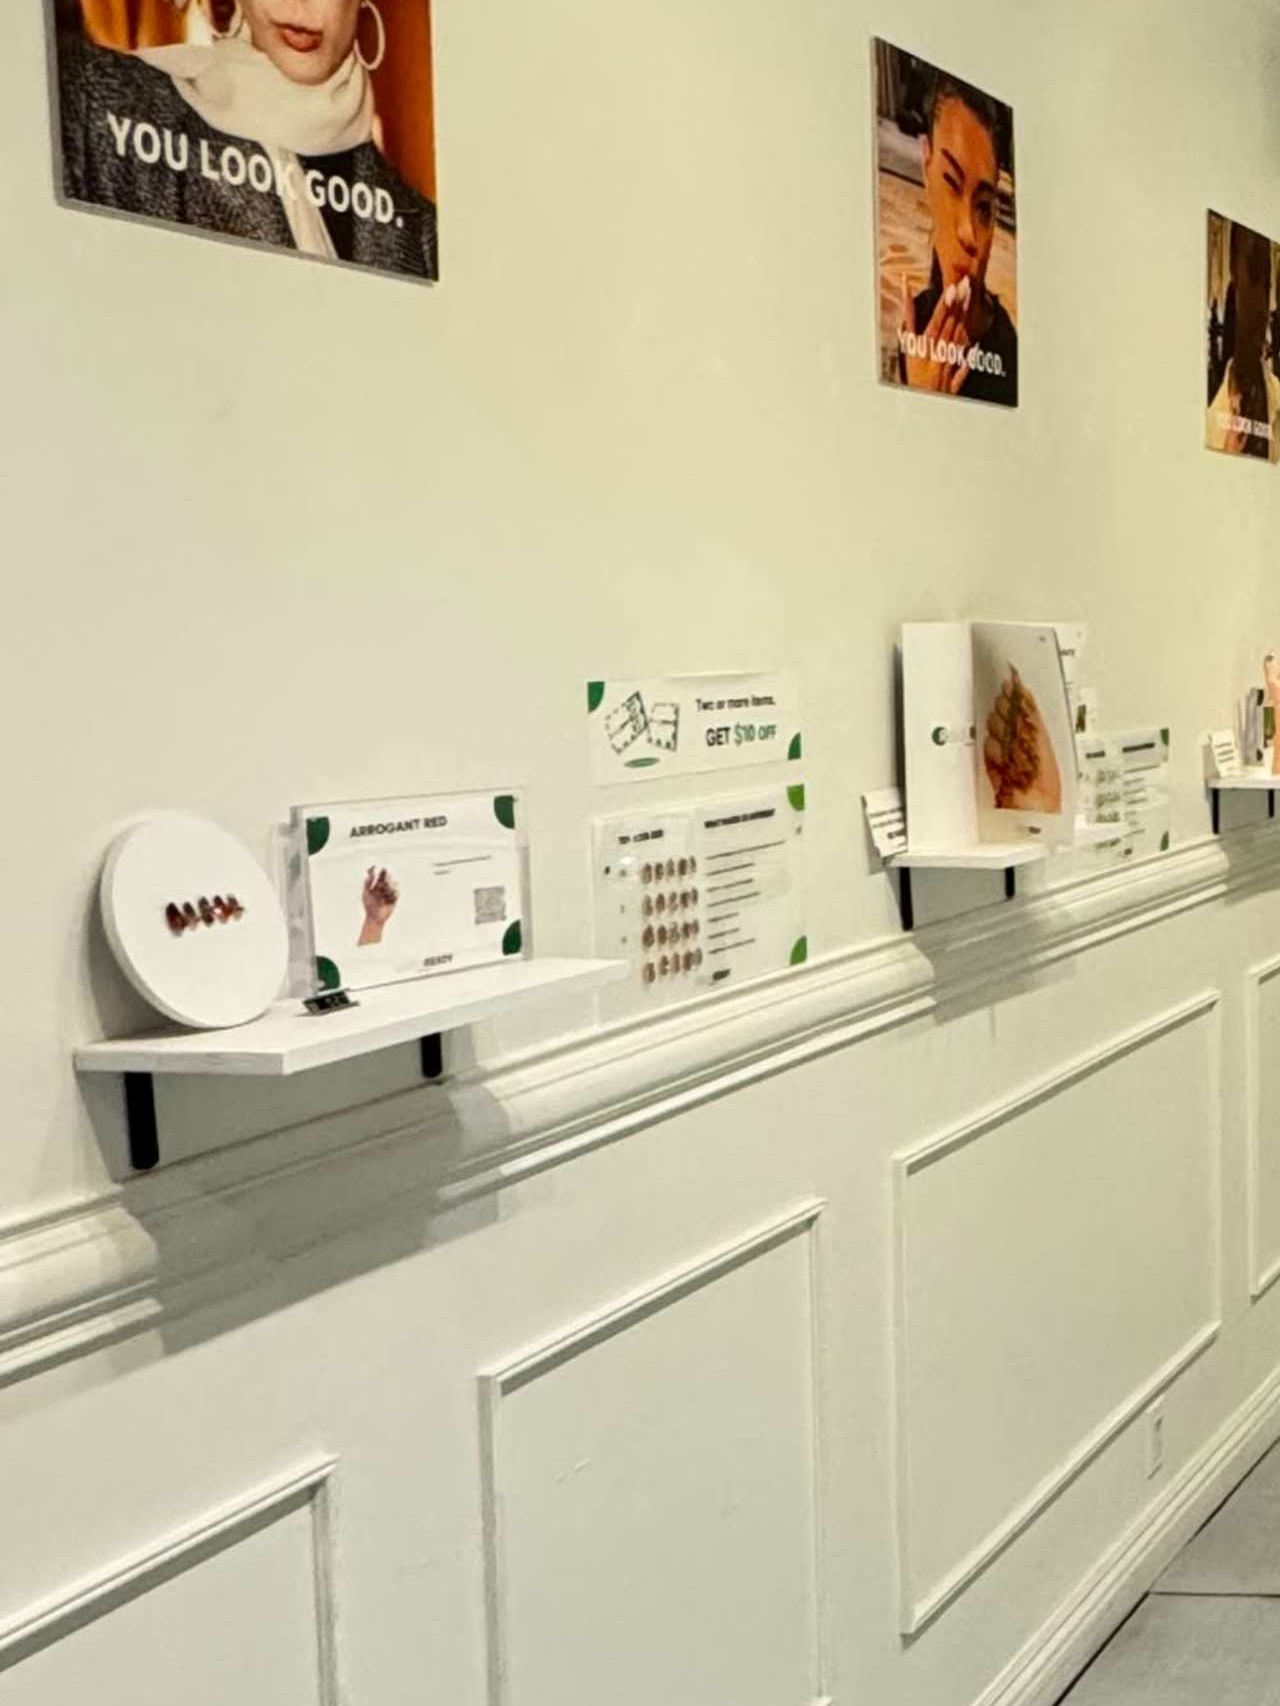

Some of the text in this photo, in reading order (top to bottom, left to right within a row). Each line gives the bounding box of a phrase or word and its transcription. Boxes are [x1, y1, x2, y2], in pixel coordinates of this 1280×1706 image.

[106, 111, 405, 227] YOU LOOK GOOD.
[898, 326, 927, 359] YOU
[930, 337, 965, 367] LOOK
[696, 698, 715, 712] Two
[716, 701, 726, 711] or
[727, 698, 749, 710] more
[705, 723, 778, 747] GET $10 OFF
[350, 814, 449, 839] ARROGANT RED
